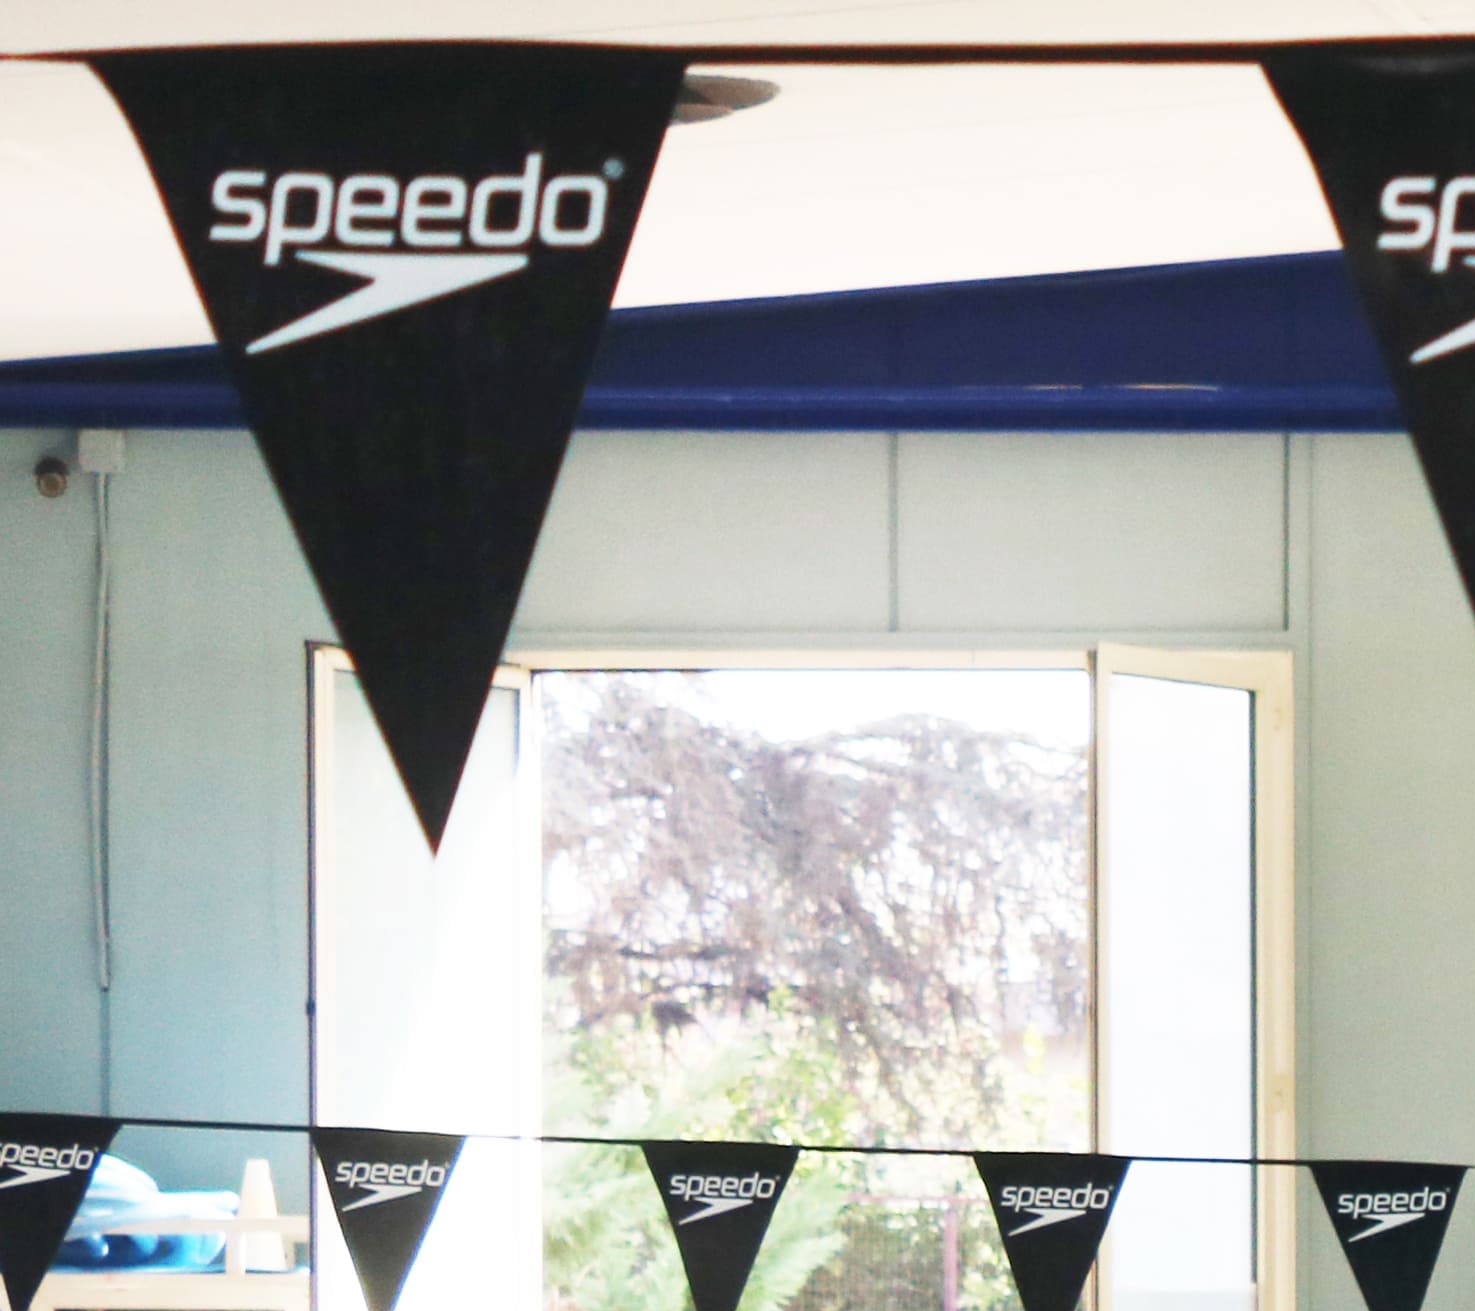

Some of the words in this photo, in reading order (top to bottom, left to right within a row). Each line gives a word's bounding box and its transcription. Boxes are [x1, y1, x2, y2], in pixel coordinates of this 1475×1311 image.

[209, 153, 605, 265] speedo
[0, 1144, 94, 1170] peedo
[336, 1160, 445, 1189] speedo
[670, 1173, 774, 1201] speedo
[1001, 1184, 1109, 1214] speedo
[1338, 1187, 1446, 1217] speedo
